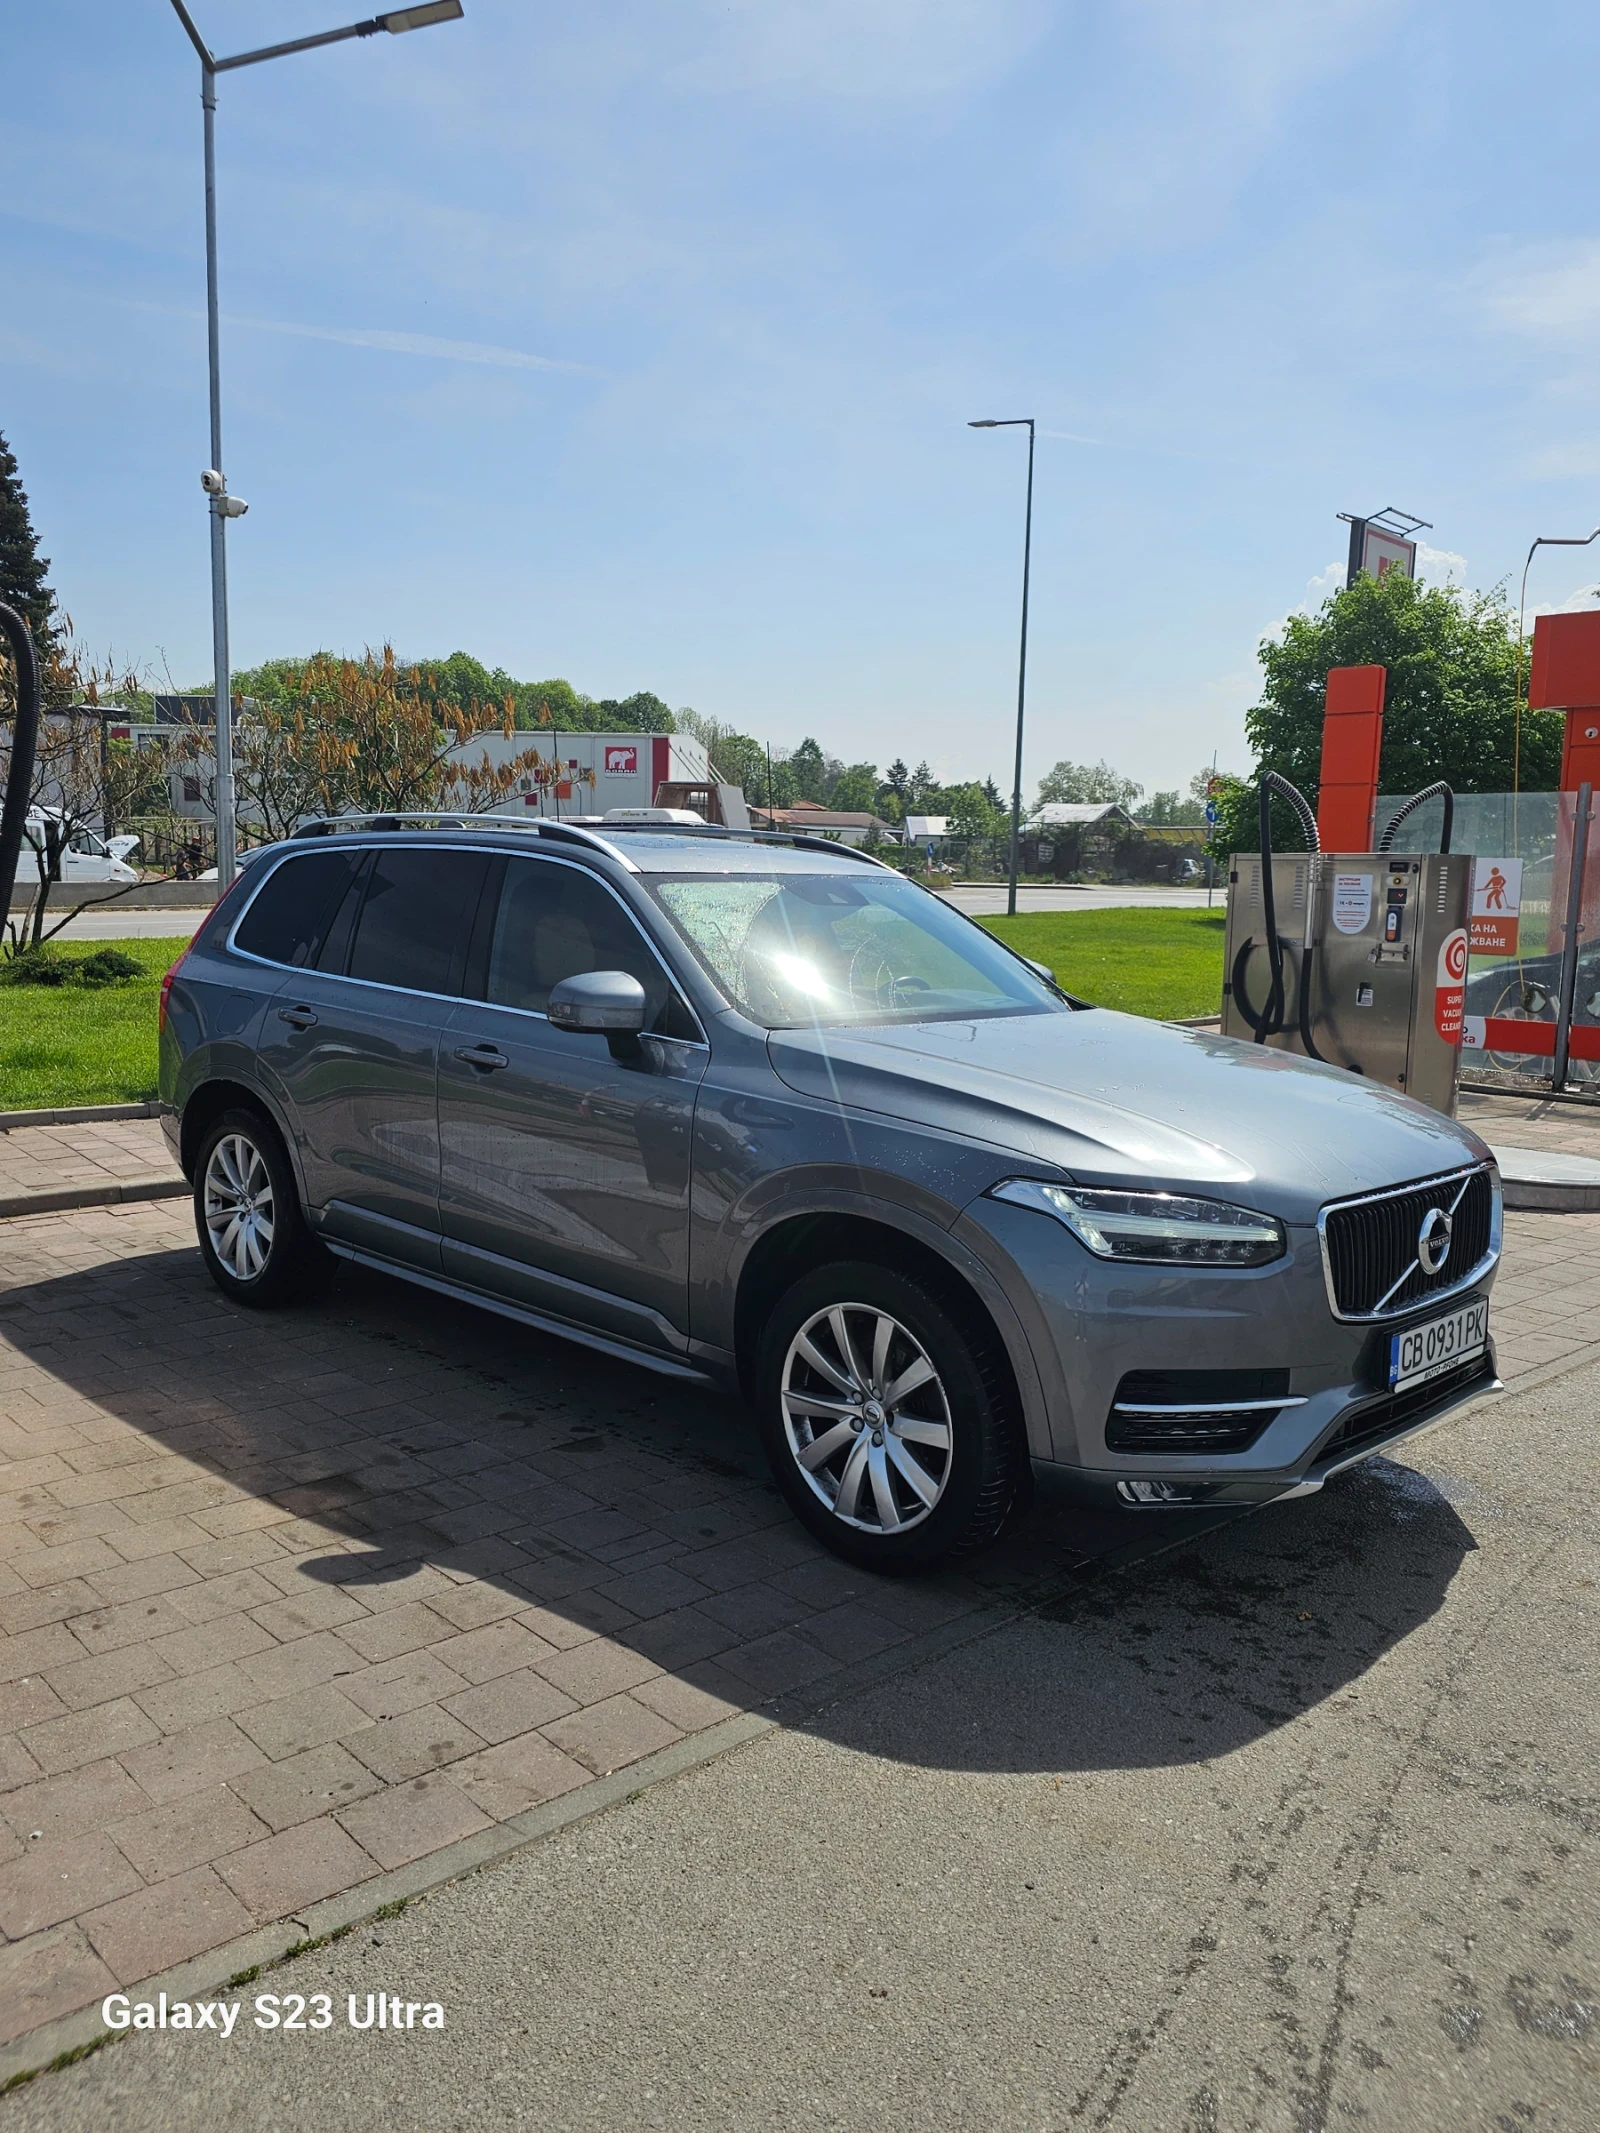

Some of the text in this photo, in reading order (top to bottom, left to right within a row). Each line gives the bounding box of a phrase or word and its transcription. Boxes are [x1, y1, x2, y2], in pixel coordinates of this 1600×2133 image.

[1483, 924, 1497, 933] НА
[1469, 936, 1506, 947] ЖВАНЕ
[1429, 1236, 1449, 1248] VOLVO
